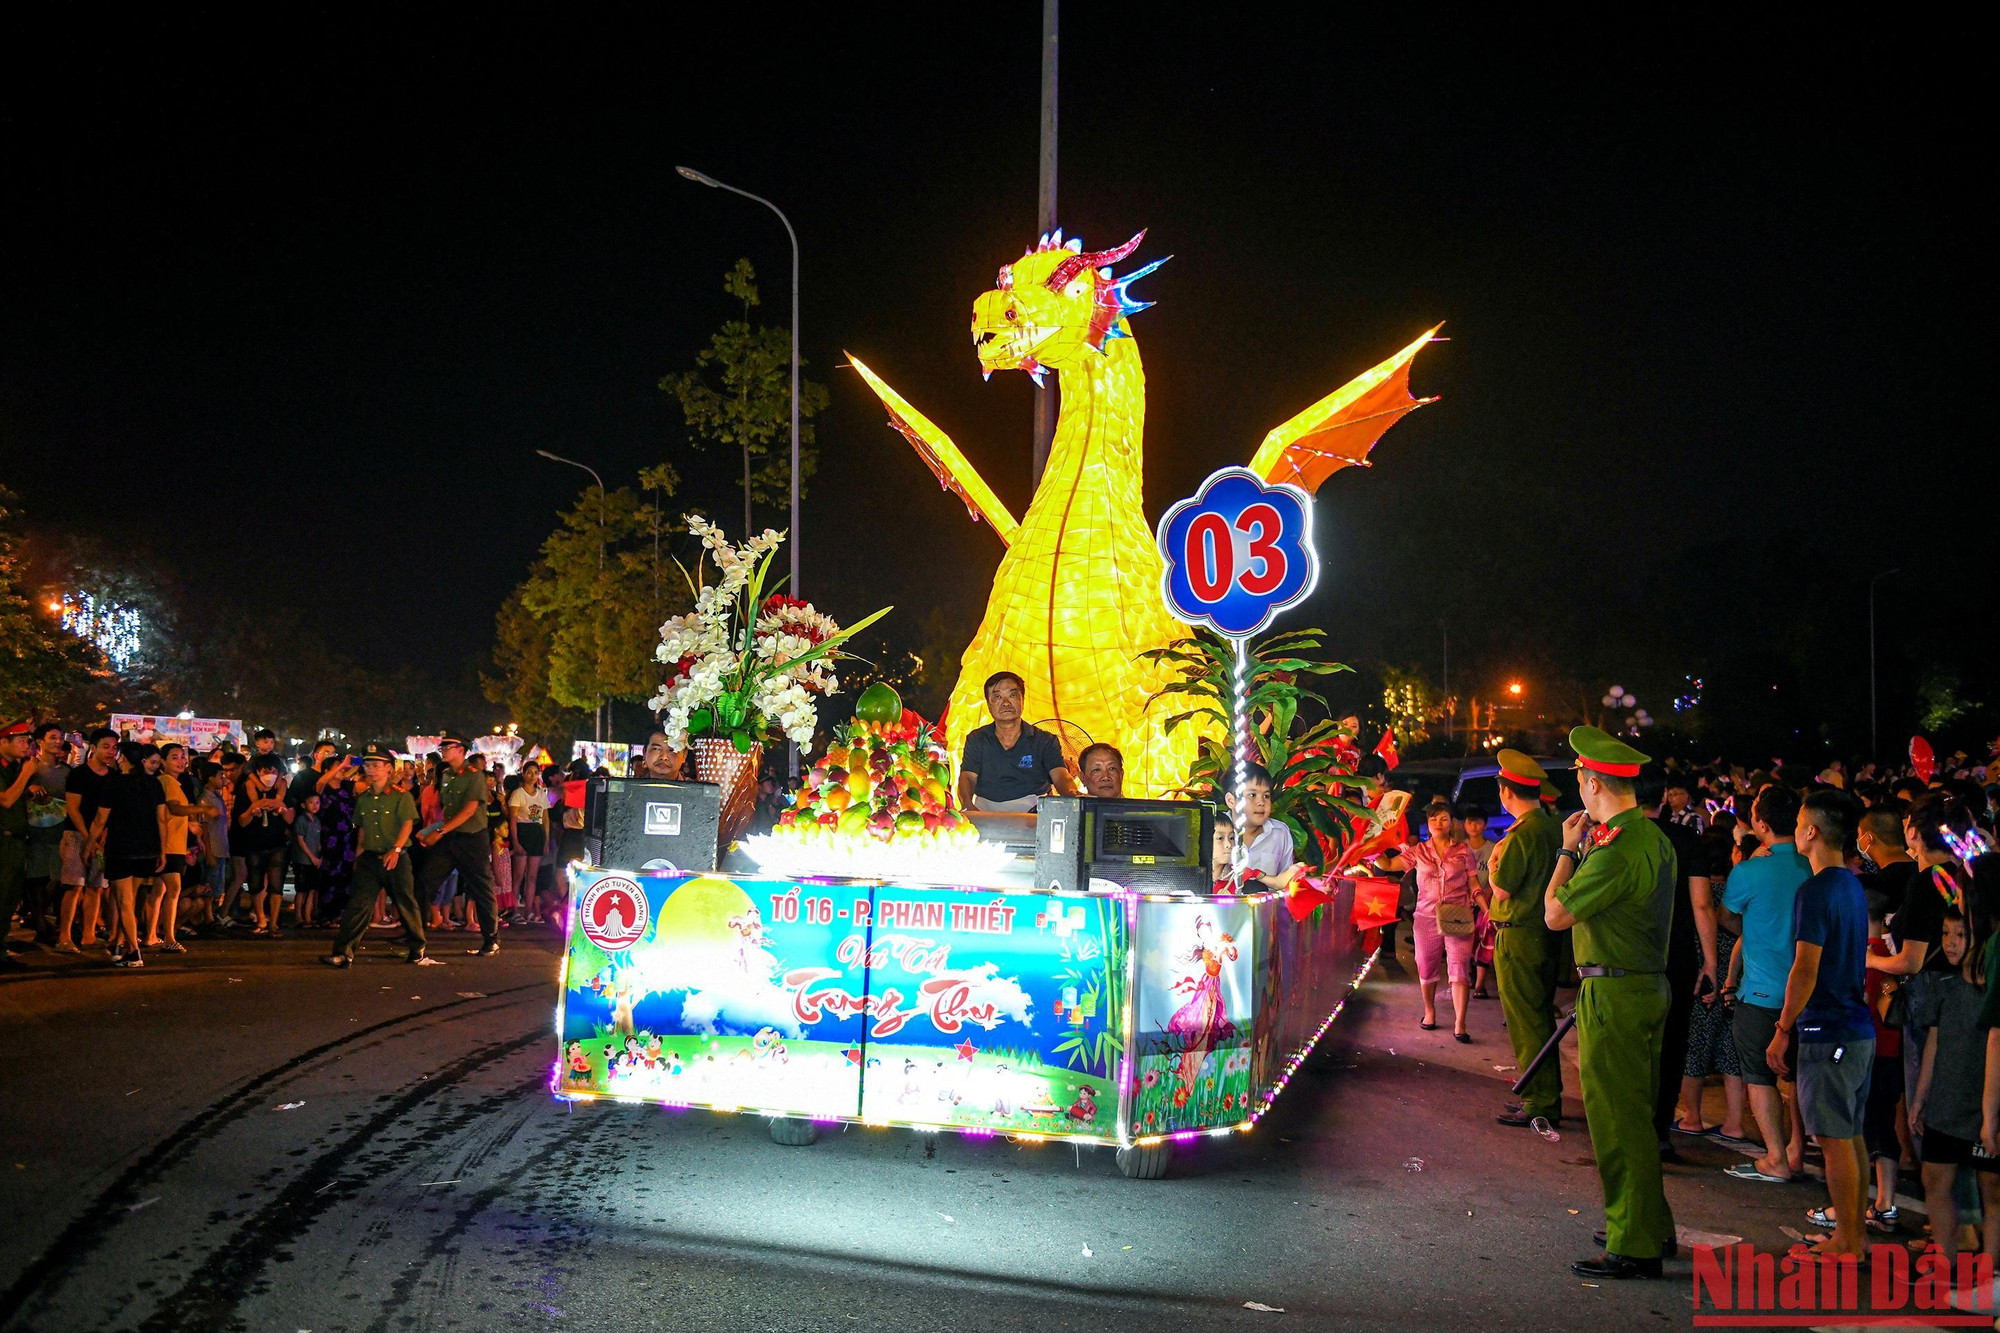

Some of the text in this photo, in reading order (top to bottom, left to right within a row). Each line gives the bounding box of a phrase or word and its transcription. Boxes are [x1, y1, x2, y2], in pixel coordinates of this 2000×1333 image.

[1185, 502, 1288, 604] 03
[595, 880, 610, 893] PHỐ
[611, 880, 635, 894] TUYÊN
[634, 893, 645, 921] QUANG
[771, 887, 801, 922] TỔ
[806, 898, 832, 924] 16
[879, 901, 944, 930] PHAN
[951, 897, 1016, 933] THIẾT
[837, 934, 951, 973] Vui Tết
[785, 970, 997, 1036] Trung Thu
